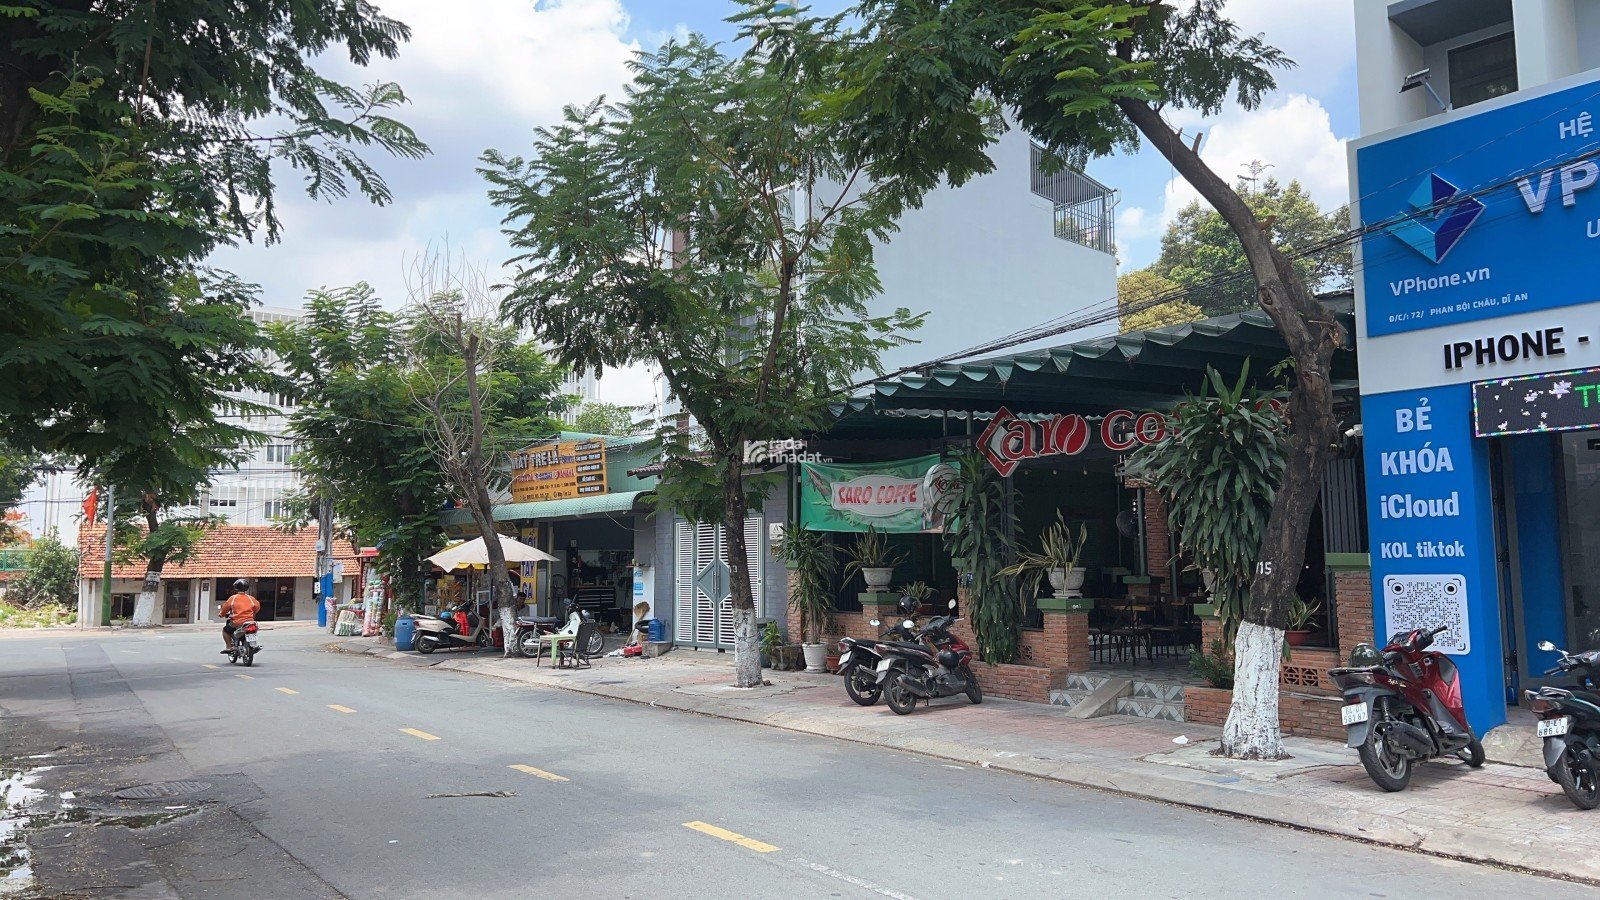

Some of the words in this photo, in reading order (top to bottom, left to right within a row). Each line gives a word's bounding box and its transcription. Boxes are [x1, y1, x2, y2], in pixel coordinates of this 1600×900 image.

[1559, 111, 1594, 139] HỆ
[1390, 266, 1490, 297] VPhone.vn
[1430, 306, 1454, 316] PHAN
[1456, 302, 1471, 313] BỘI
[1514, 292, 1529, 302] AN
[1443, 327, 1566, 370] IPHONE
[1395, 397, 1432, 433] BẺ
[1381, 442, 1455, 476] KHÓA
[838, 485, 873, 504] CARO
[876, 483, 918, 504] COFFE
[1380, 491, 1460, 519] iCloud
[1381, 542, 1412, 559] KOL
[1416, 541, 1466, 558] tiktok
